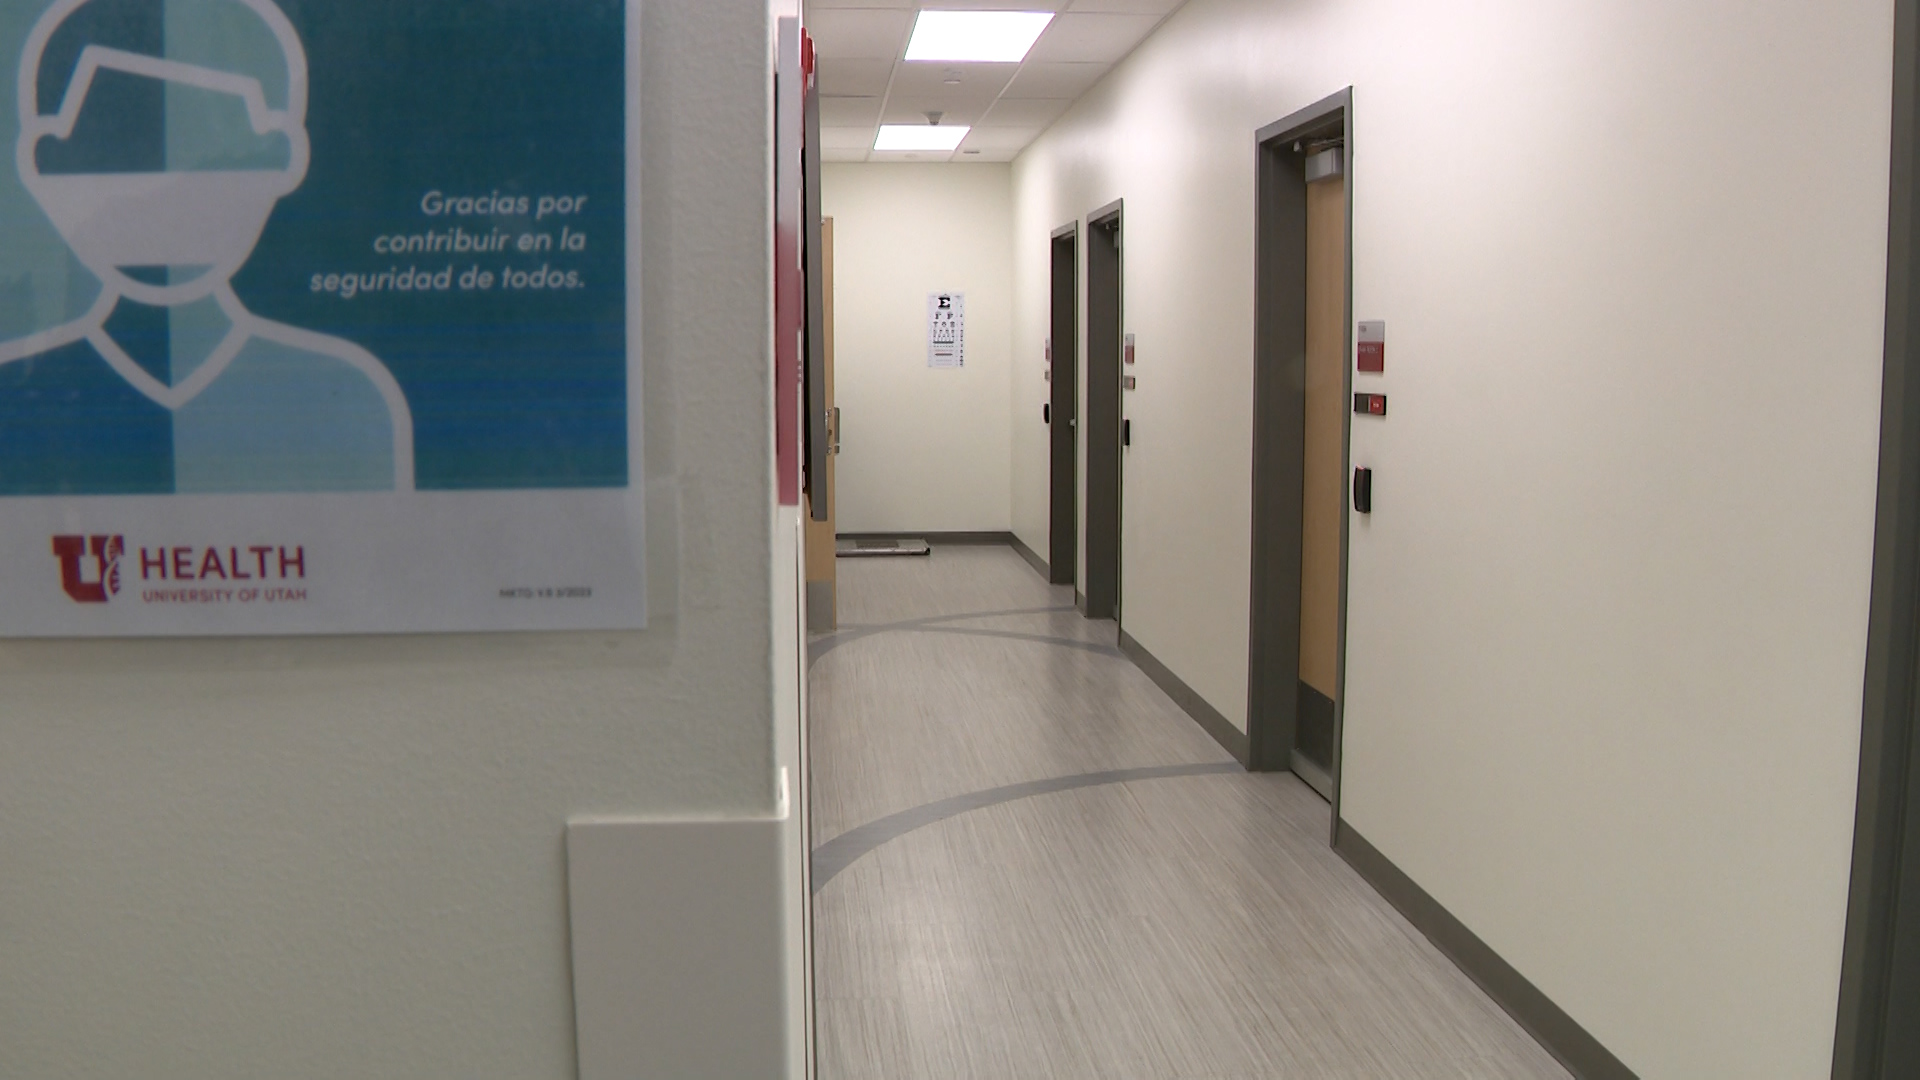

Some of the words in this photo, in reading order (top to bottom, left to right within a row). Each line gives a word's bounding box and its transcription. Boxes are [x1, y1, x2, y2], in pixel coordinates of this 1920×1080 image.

[420, 189, 529, 216] Gracias
[536, 193, 588, 220] por
[373, 227, 511, 254] contribuir
[516, 231, 552, 252] en
[560, 225, 586, 252] la
[309, 264, 451, 299] seguridad
[458, 263, 494, 289] de
[501, 263, 586, 289] todos.
[938, 297, 950, 309] E
[139, 544, 305, 580] HEALTH
[142, 588, 233, 604] UNIVERSITY
[237, 588, 260, 603] OF
[264, 587, 307, 602] UTAH
